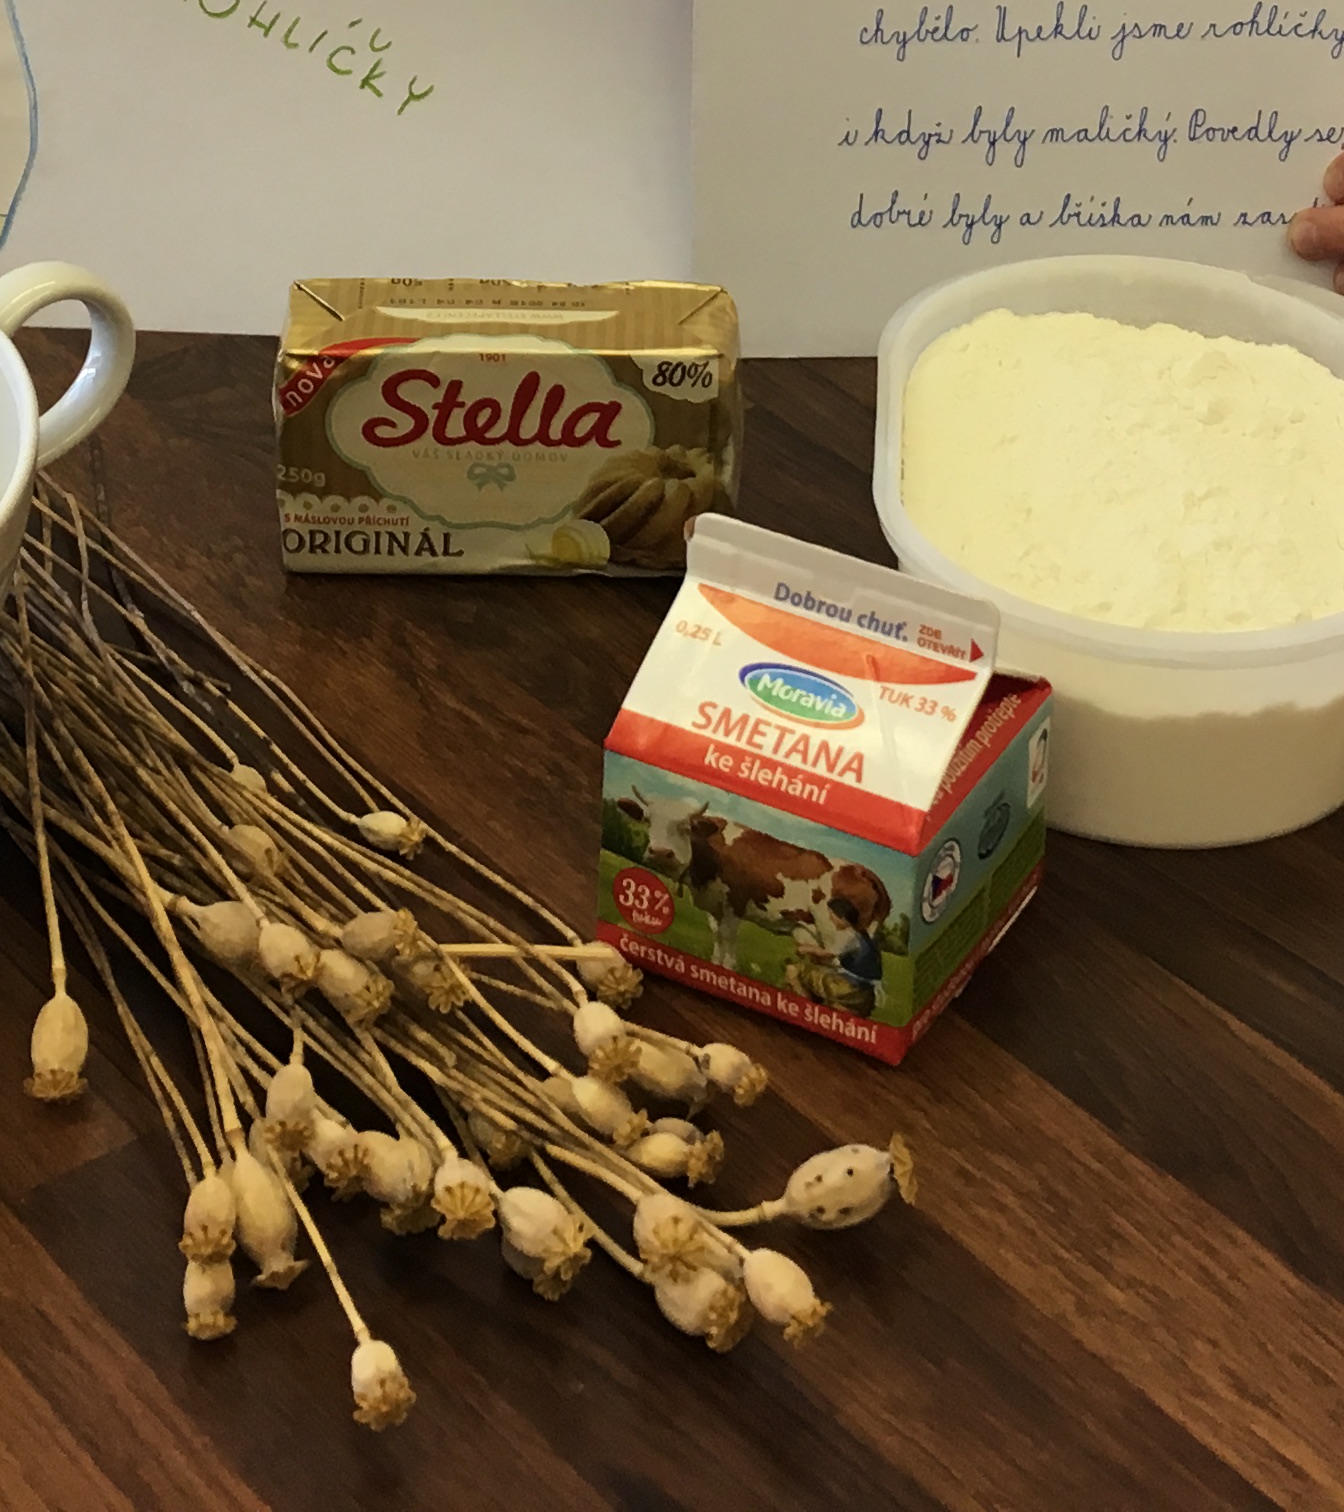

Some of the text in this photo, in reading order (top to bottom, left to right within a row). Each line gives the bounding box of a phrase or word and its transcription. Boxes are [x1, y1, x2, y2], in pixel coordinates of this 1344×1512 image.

[995, 0, 1101, 59] Upekli
[1110, 12, 1194, 62] jsme
[837, 117, 859, 146] i
[864, 107, 954, 161] když
[961, 105, 1036, 168] byly
[1187, 107, 1302, 163] Povedly
[850, 190, 933, 229] dobré
[942, 192, 1011, 246] byly
[1019, 209, 1044, 227] a
[1048, 192, 1152, 229] bříška
[1158, 197, 1223, 229] nám
[478, 352, 507, 363] 1901
[652, 361, 713, 389] 80%
[361, 368, 623, 449] Stella
[276, 464, 326, 487] 250g
[282, 527, 464, 558] ORIGINÁL
[773, 582, 854, 623] Dobrou
[756, 673, 848, 720] Moravia
[879, 685, 915, 709] TUK
[914, 697, 939, 717] 33
[691, 700, 865, 784] SMETANA
[704, 744, 831, 806] ke šlehání
[619, 932, 877, 1045] čerstvá smetana ke šlehání
